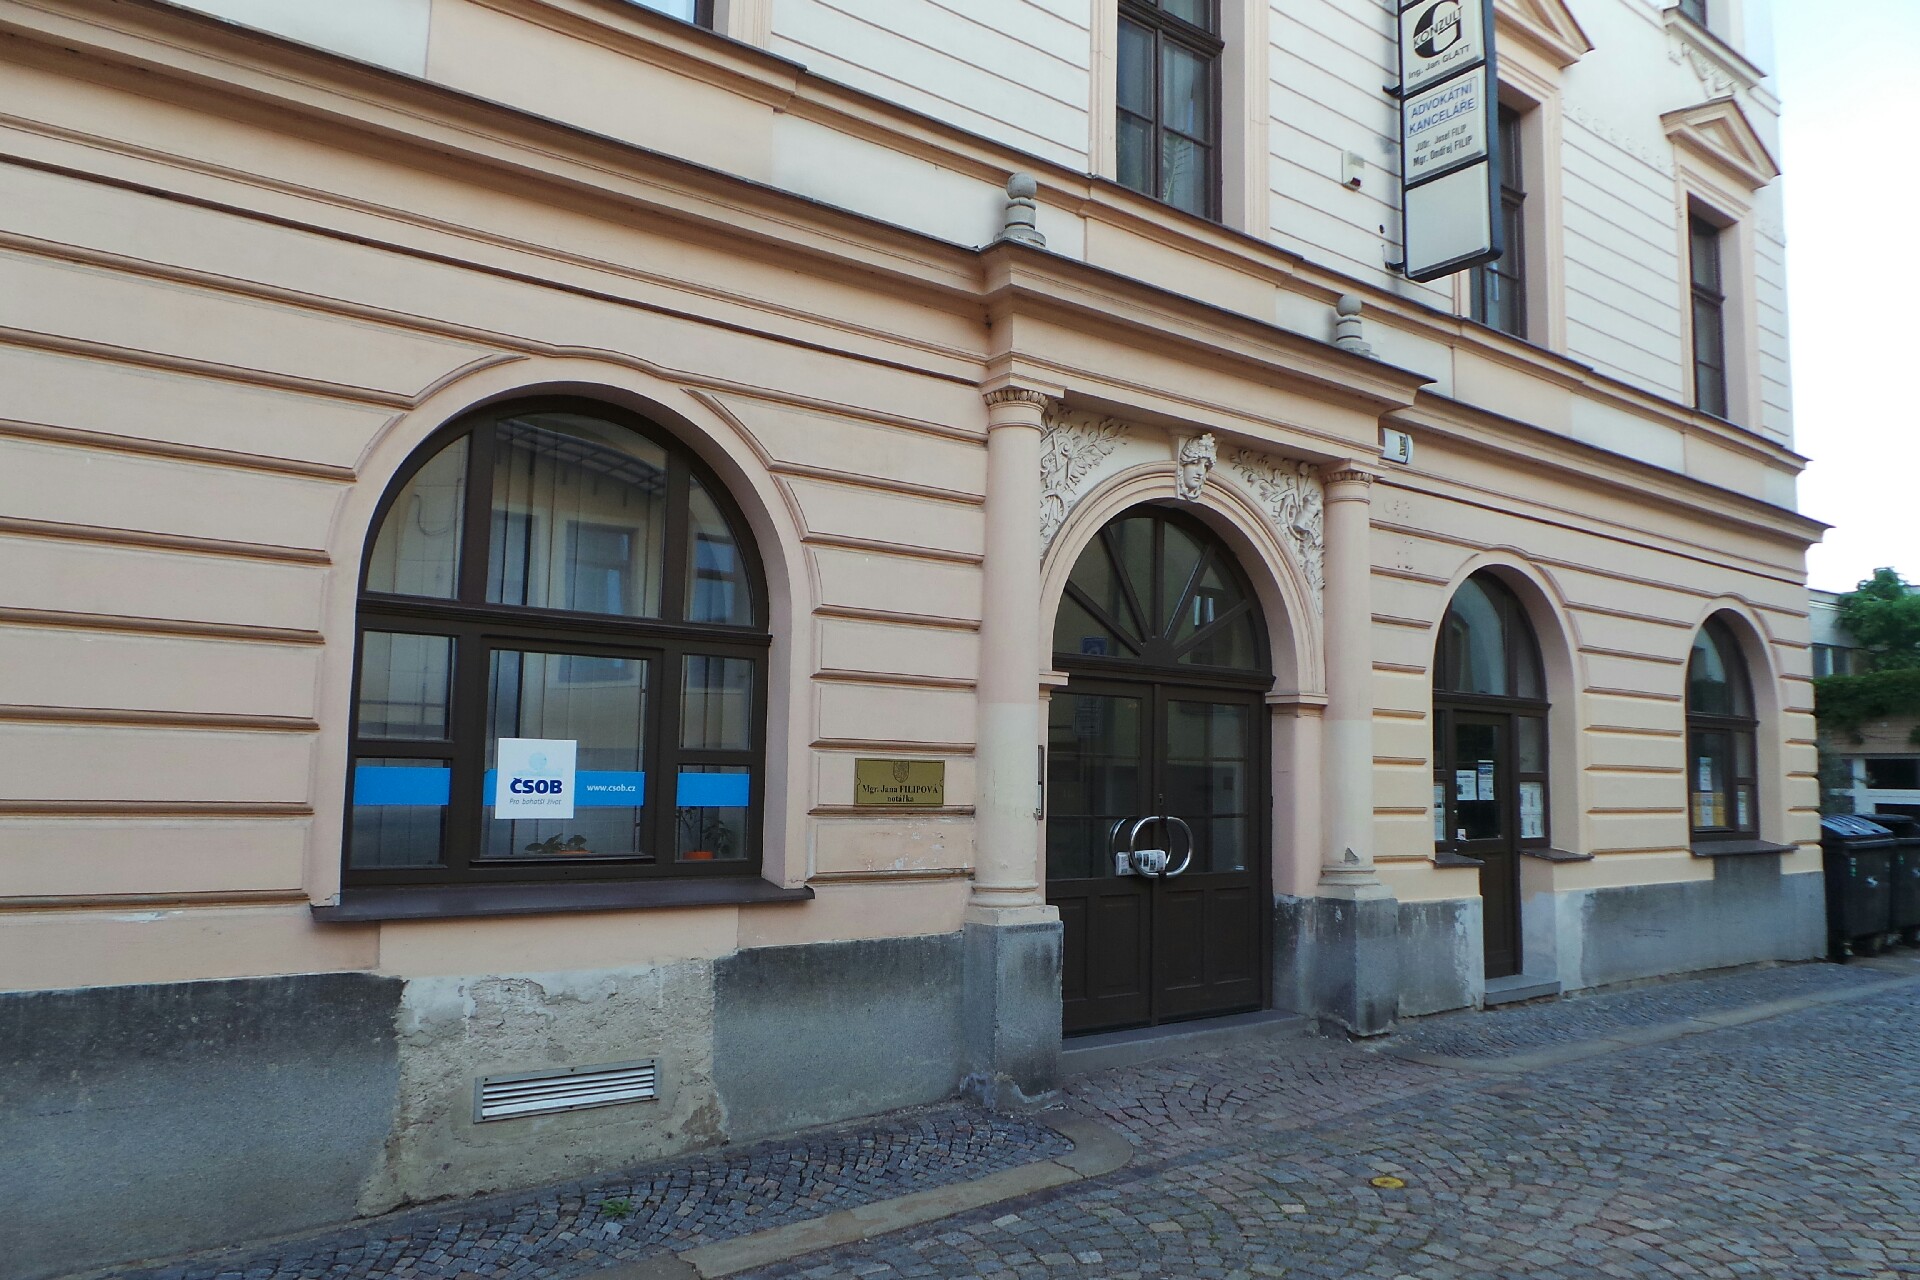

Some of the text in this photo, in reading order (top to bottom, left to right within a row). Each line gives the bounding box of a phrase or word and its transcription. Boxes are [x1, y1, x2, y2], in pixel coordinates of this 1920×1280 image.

[1414, 5, 1463, 48] KONZULT
[1408, 43, 1471, 79] Ing. Jan GLATT
[1411, 82, 1473, 118] ADVOKÁTNÍ
[1409, 97, 1475, 135] KANCELÁŘE
[1451, 123, 1467, 137] FILIP
[1413, 155, 1428, 167] Mgr.
[1454, 134, 1473, 151] FILIP
[510, 777, 562, 794] ČSOB
[586, 783, 636, 792] www.csob.cz
[862, 783, 938, 794] Mgr. Jana FILIPOVÁ
[521, 797, 545, 806] bohatší
